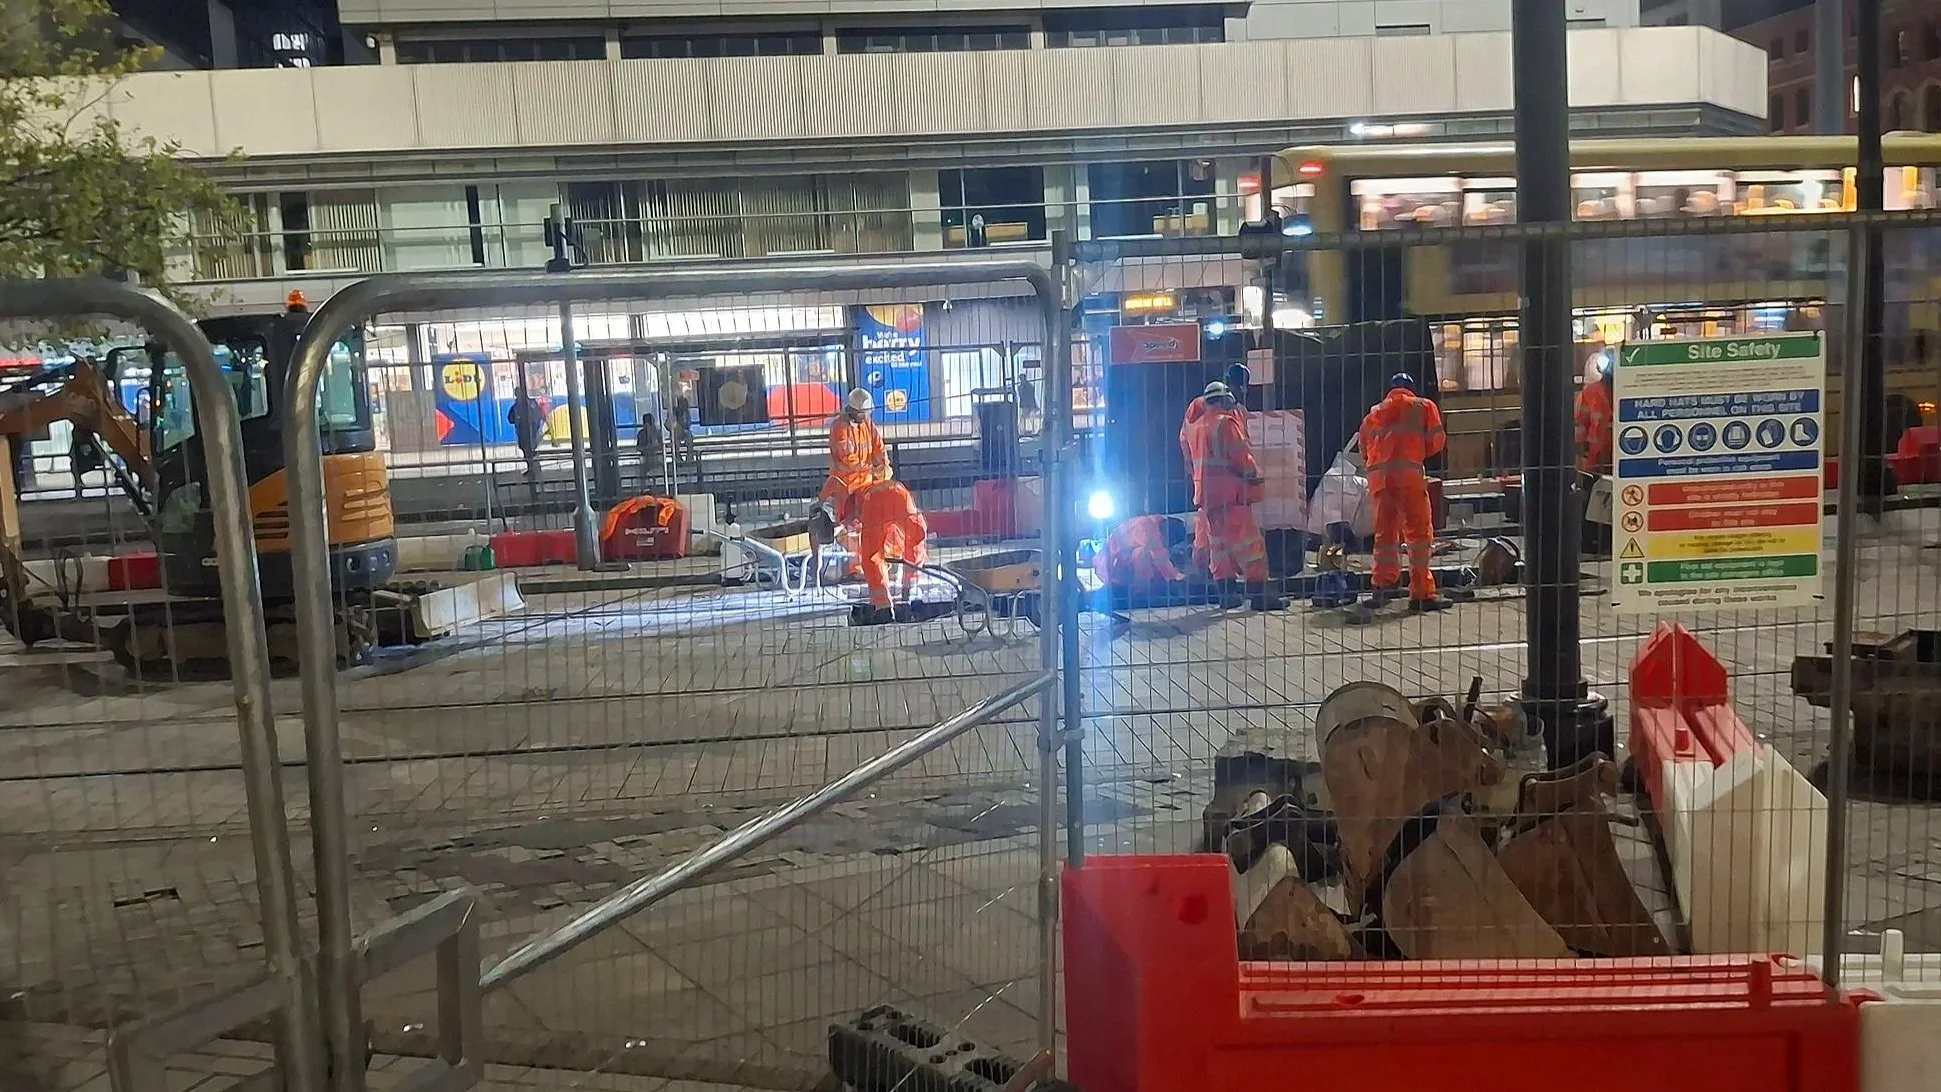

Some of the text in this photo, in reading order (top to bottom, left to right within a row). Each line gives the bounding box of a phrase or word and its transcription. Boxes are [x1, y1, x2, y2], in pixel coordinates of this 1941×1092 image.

[1688, 342, 1781, 360] Site Safety
[1634, 399, 1666, 408] HARD
[1669, 397, 1698, 407] HATS
[1701, 395, 1730, 405] MUST
[1789, 391, 1804, 400] BY
[1637, 410, 1657, 419] ALL
[1730, 405, 1747, 415] ON
